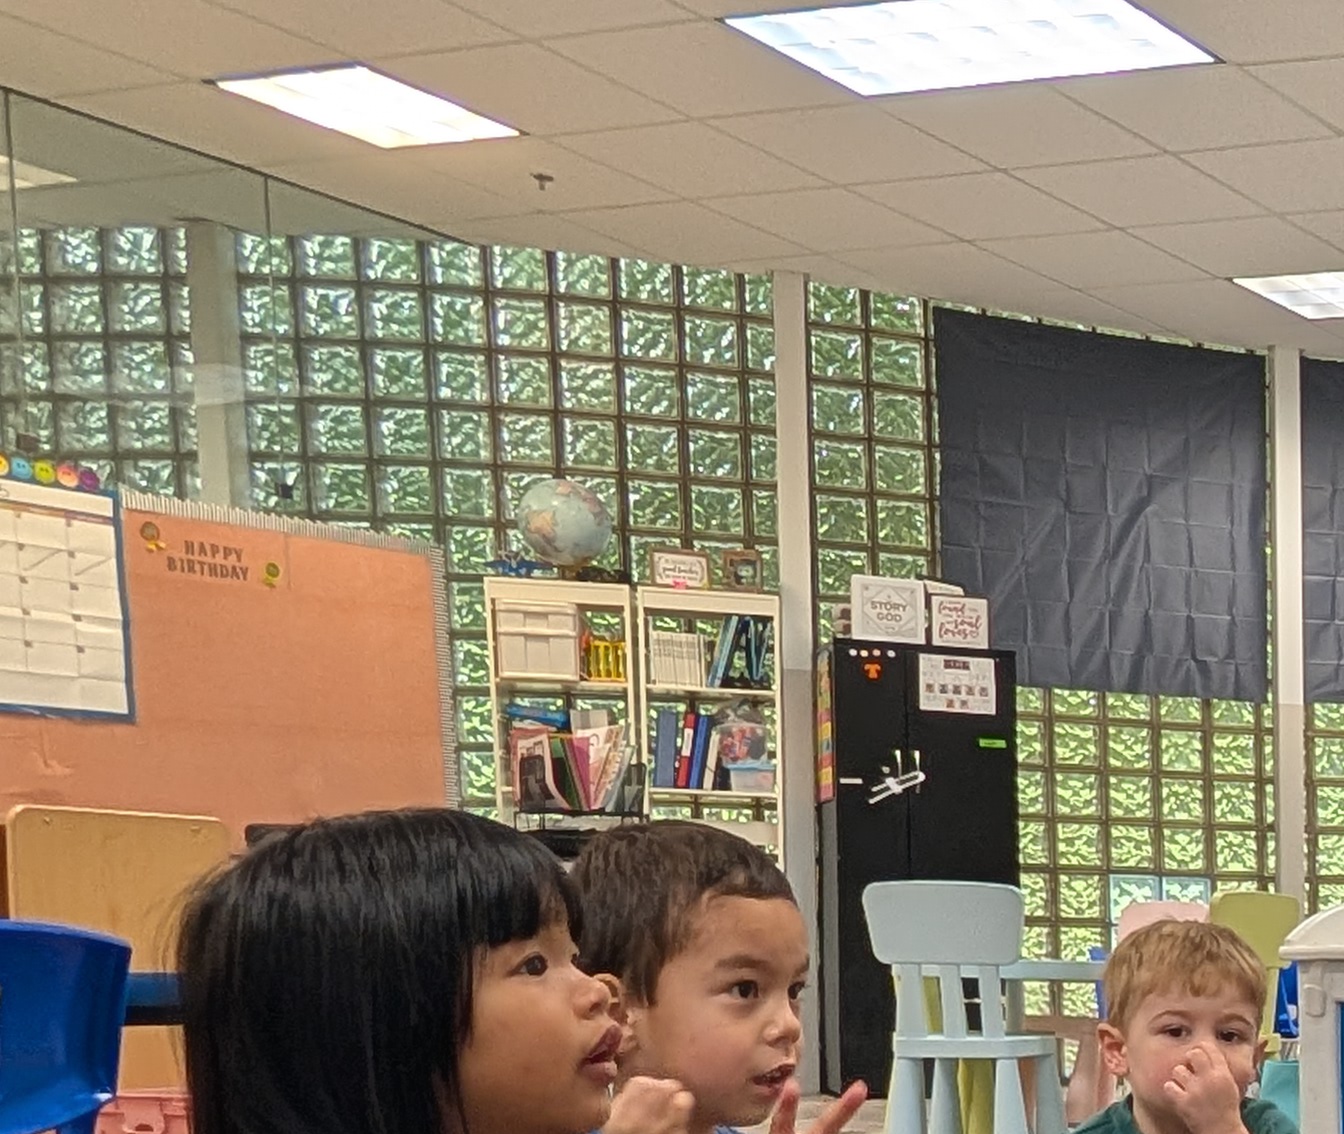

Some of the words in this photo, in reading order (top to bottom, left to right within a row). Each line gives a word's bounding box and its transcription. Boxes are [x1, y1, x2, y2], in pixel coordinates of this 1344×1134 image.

[184, 540, 243, 563] HAPPY
[167, 556, 249, 581] BIRTHDAY
[870, 600, 908, 612] STORY
[876, 612, 903, 623] GOD
